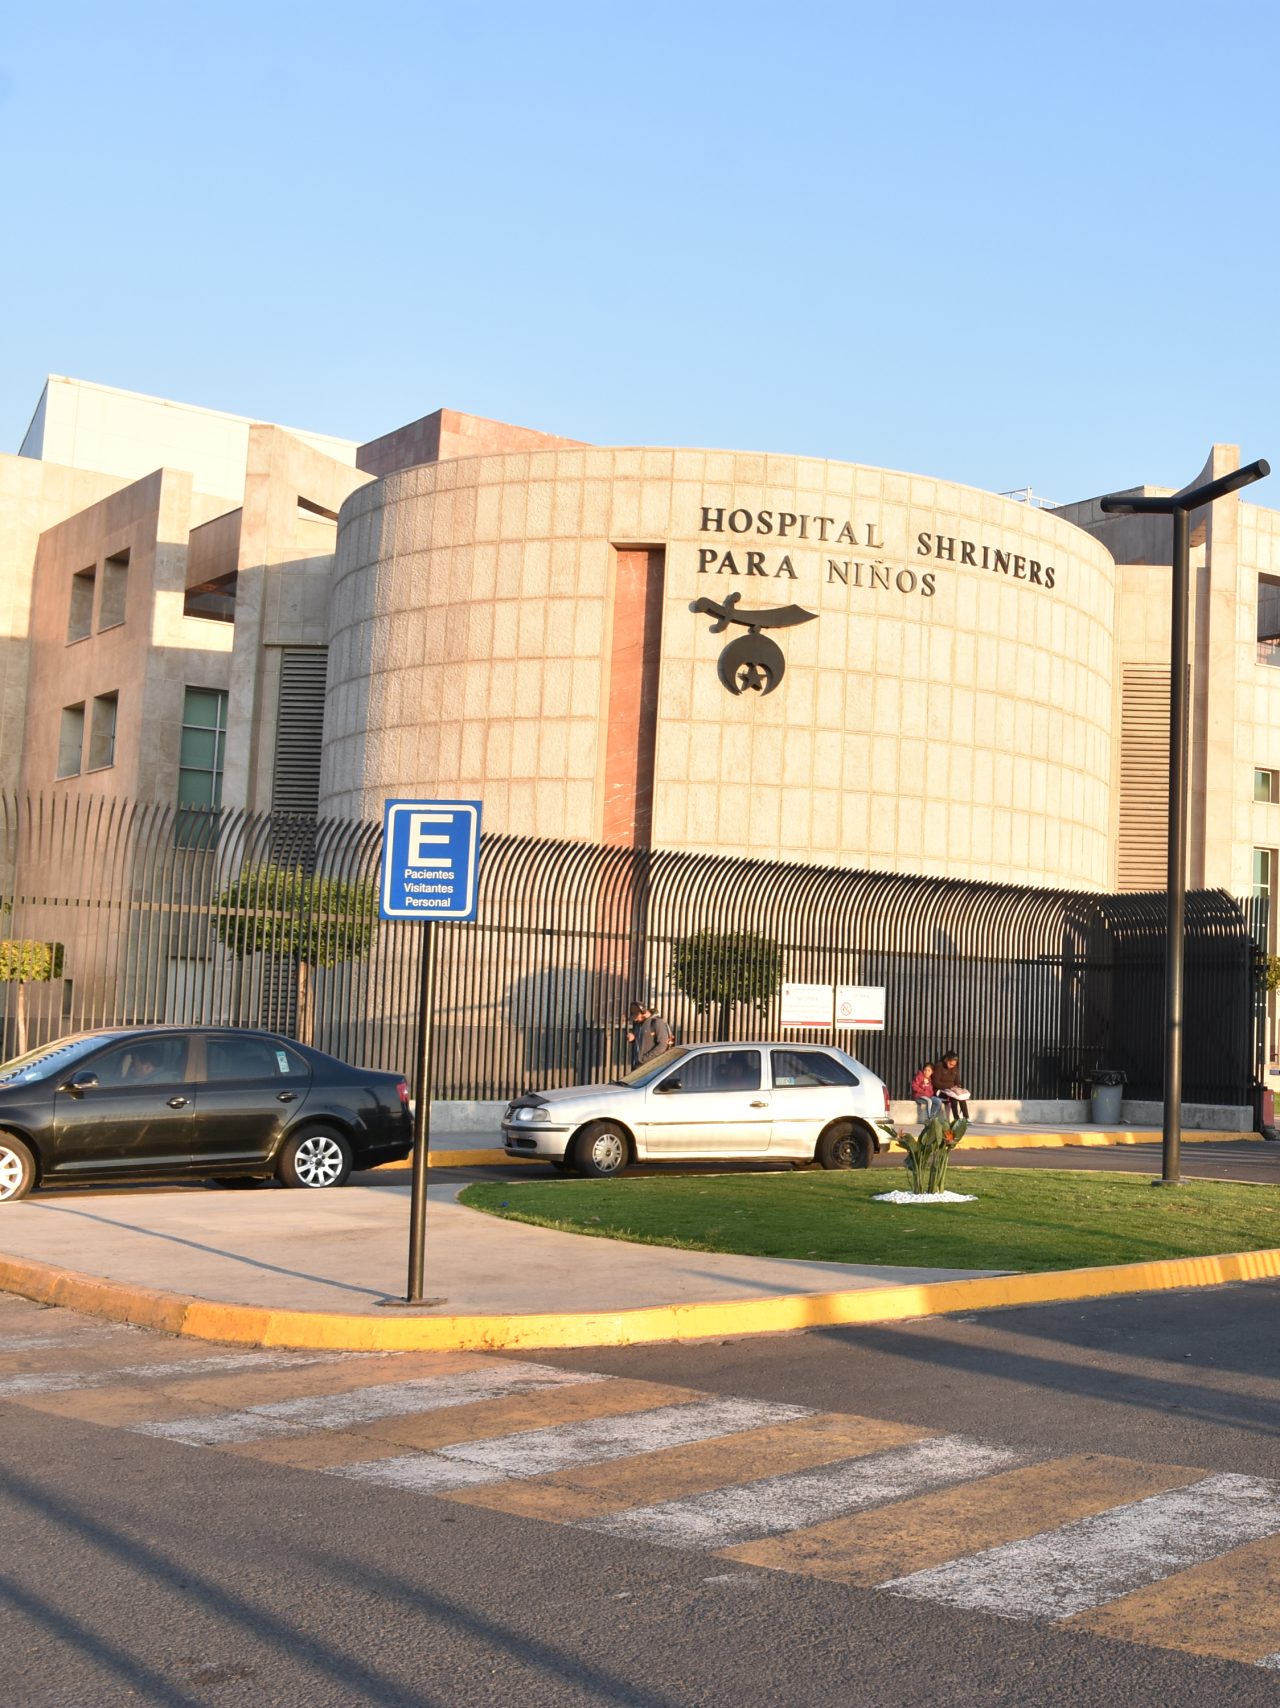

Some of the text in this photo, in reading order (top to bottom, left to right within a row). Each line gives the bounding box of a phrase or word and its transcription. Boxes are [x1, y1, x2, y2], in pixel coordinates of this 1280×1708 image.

[699, 507, 1055, 589] HOSPITAL SHRINERS
[697, 549, 936, 596] PARA NIÑOS
[408, 814, 453, 867] E
[404, 869, 454, 879] Pacientes
[404, 883, 454, 893] Visitantes
[405, 896, 451, 907] Personal
